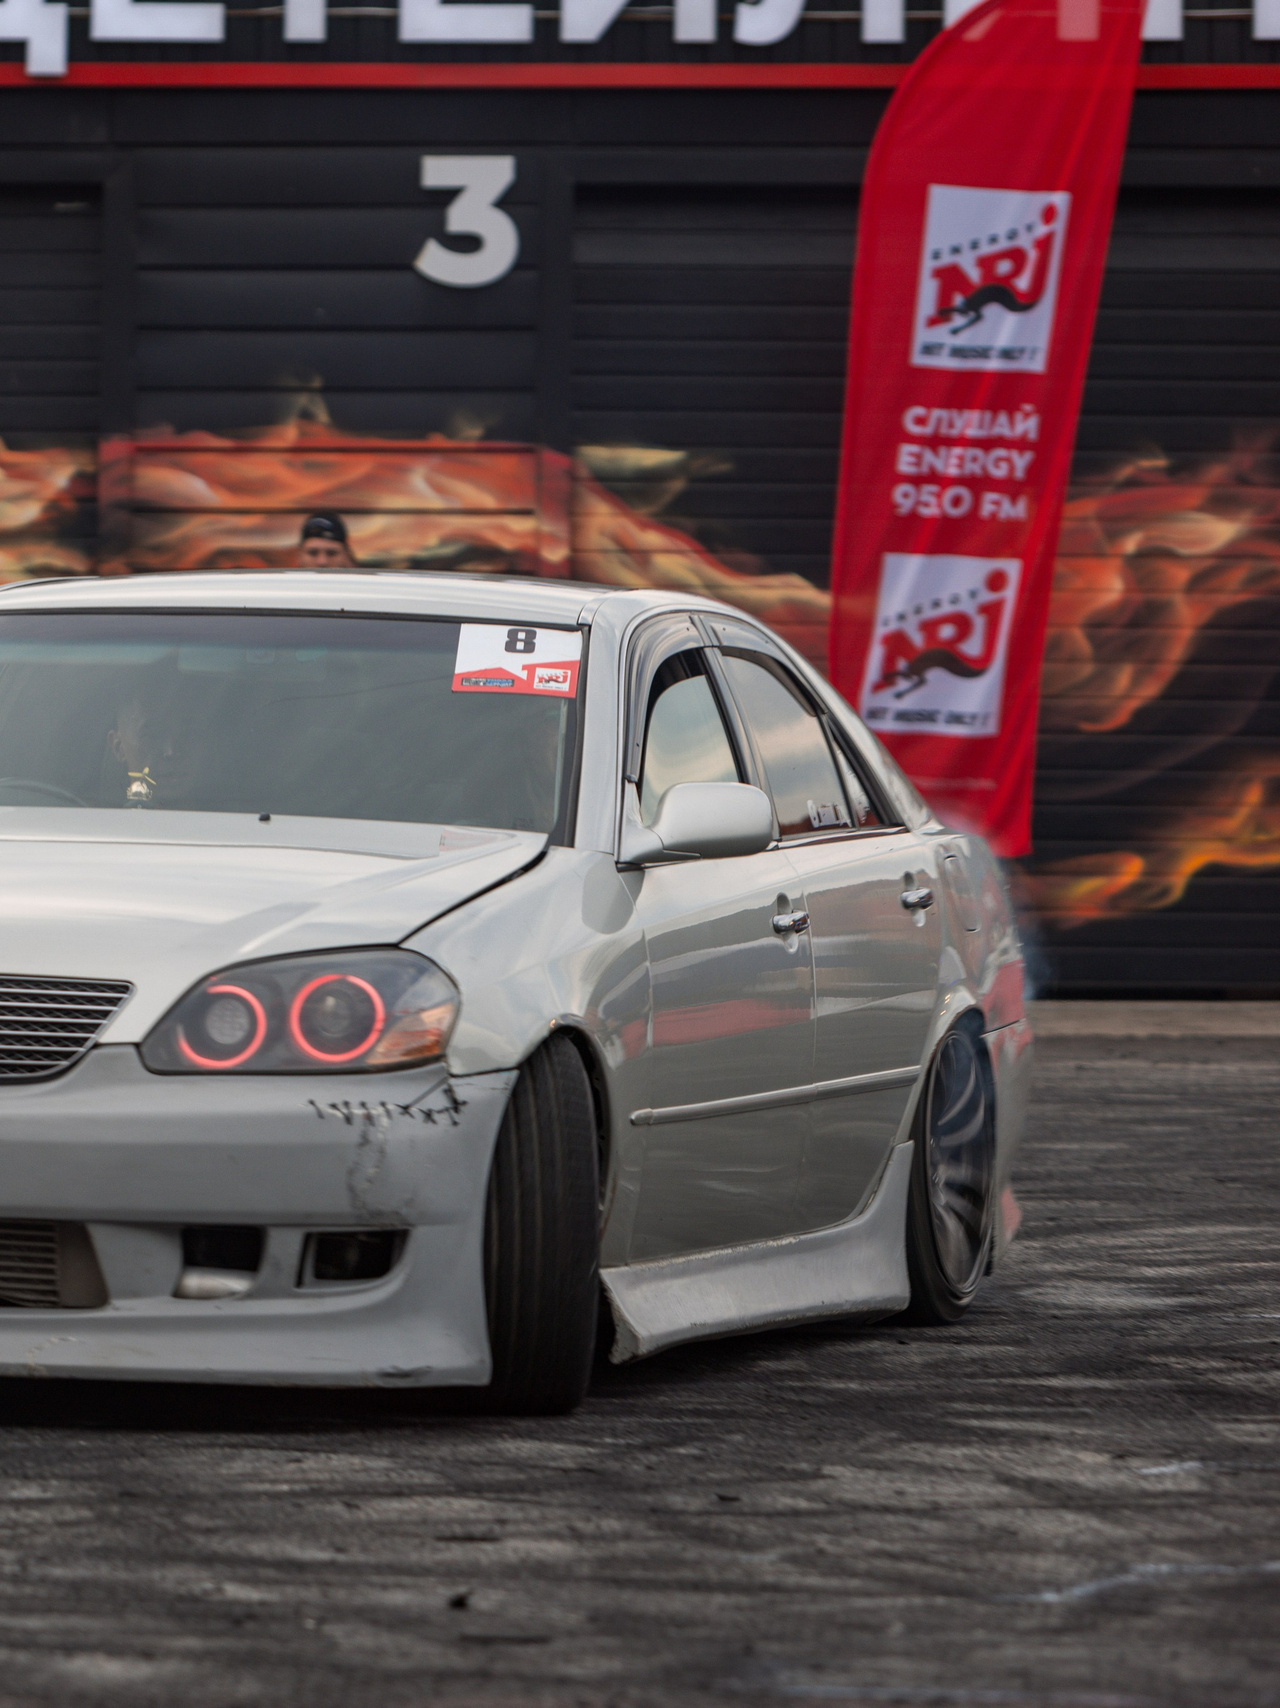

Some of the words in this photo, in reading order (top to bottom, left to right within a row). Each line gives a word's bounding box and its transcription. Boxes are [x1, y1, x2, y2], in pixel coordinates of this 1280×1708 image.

[413, 155, 519, 288] 3
[902, 404, 1040, 441] СЛУШАЙ
[896, 442, 1035, 480] ENERGY
[979, 491, 1028, 520] FM
[504, 628, 537, 653] 8
